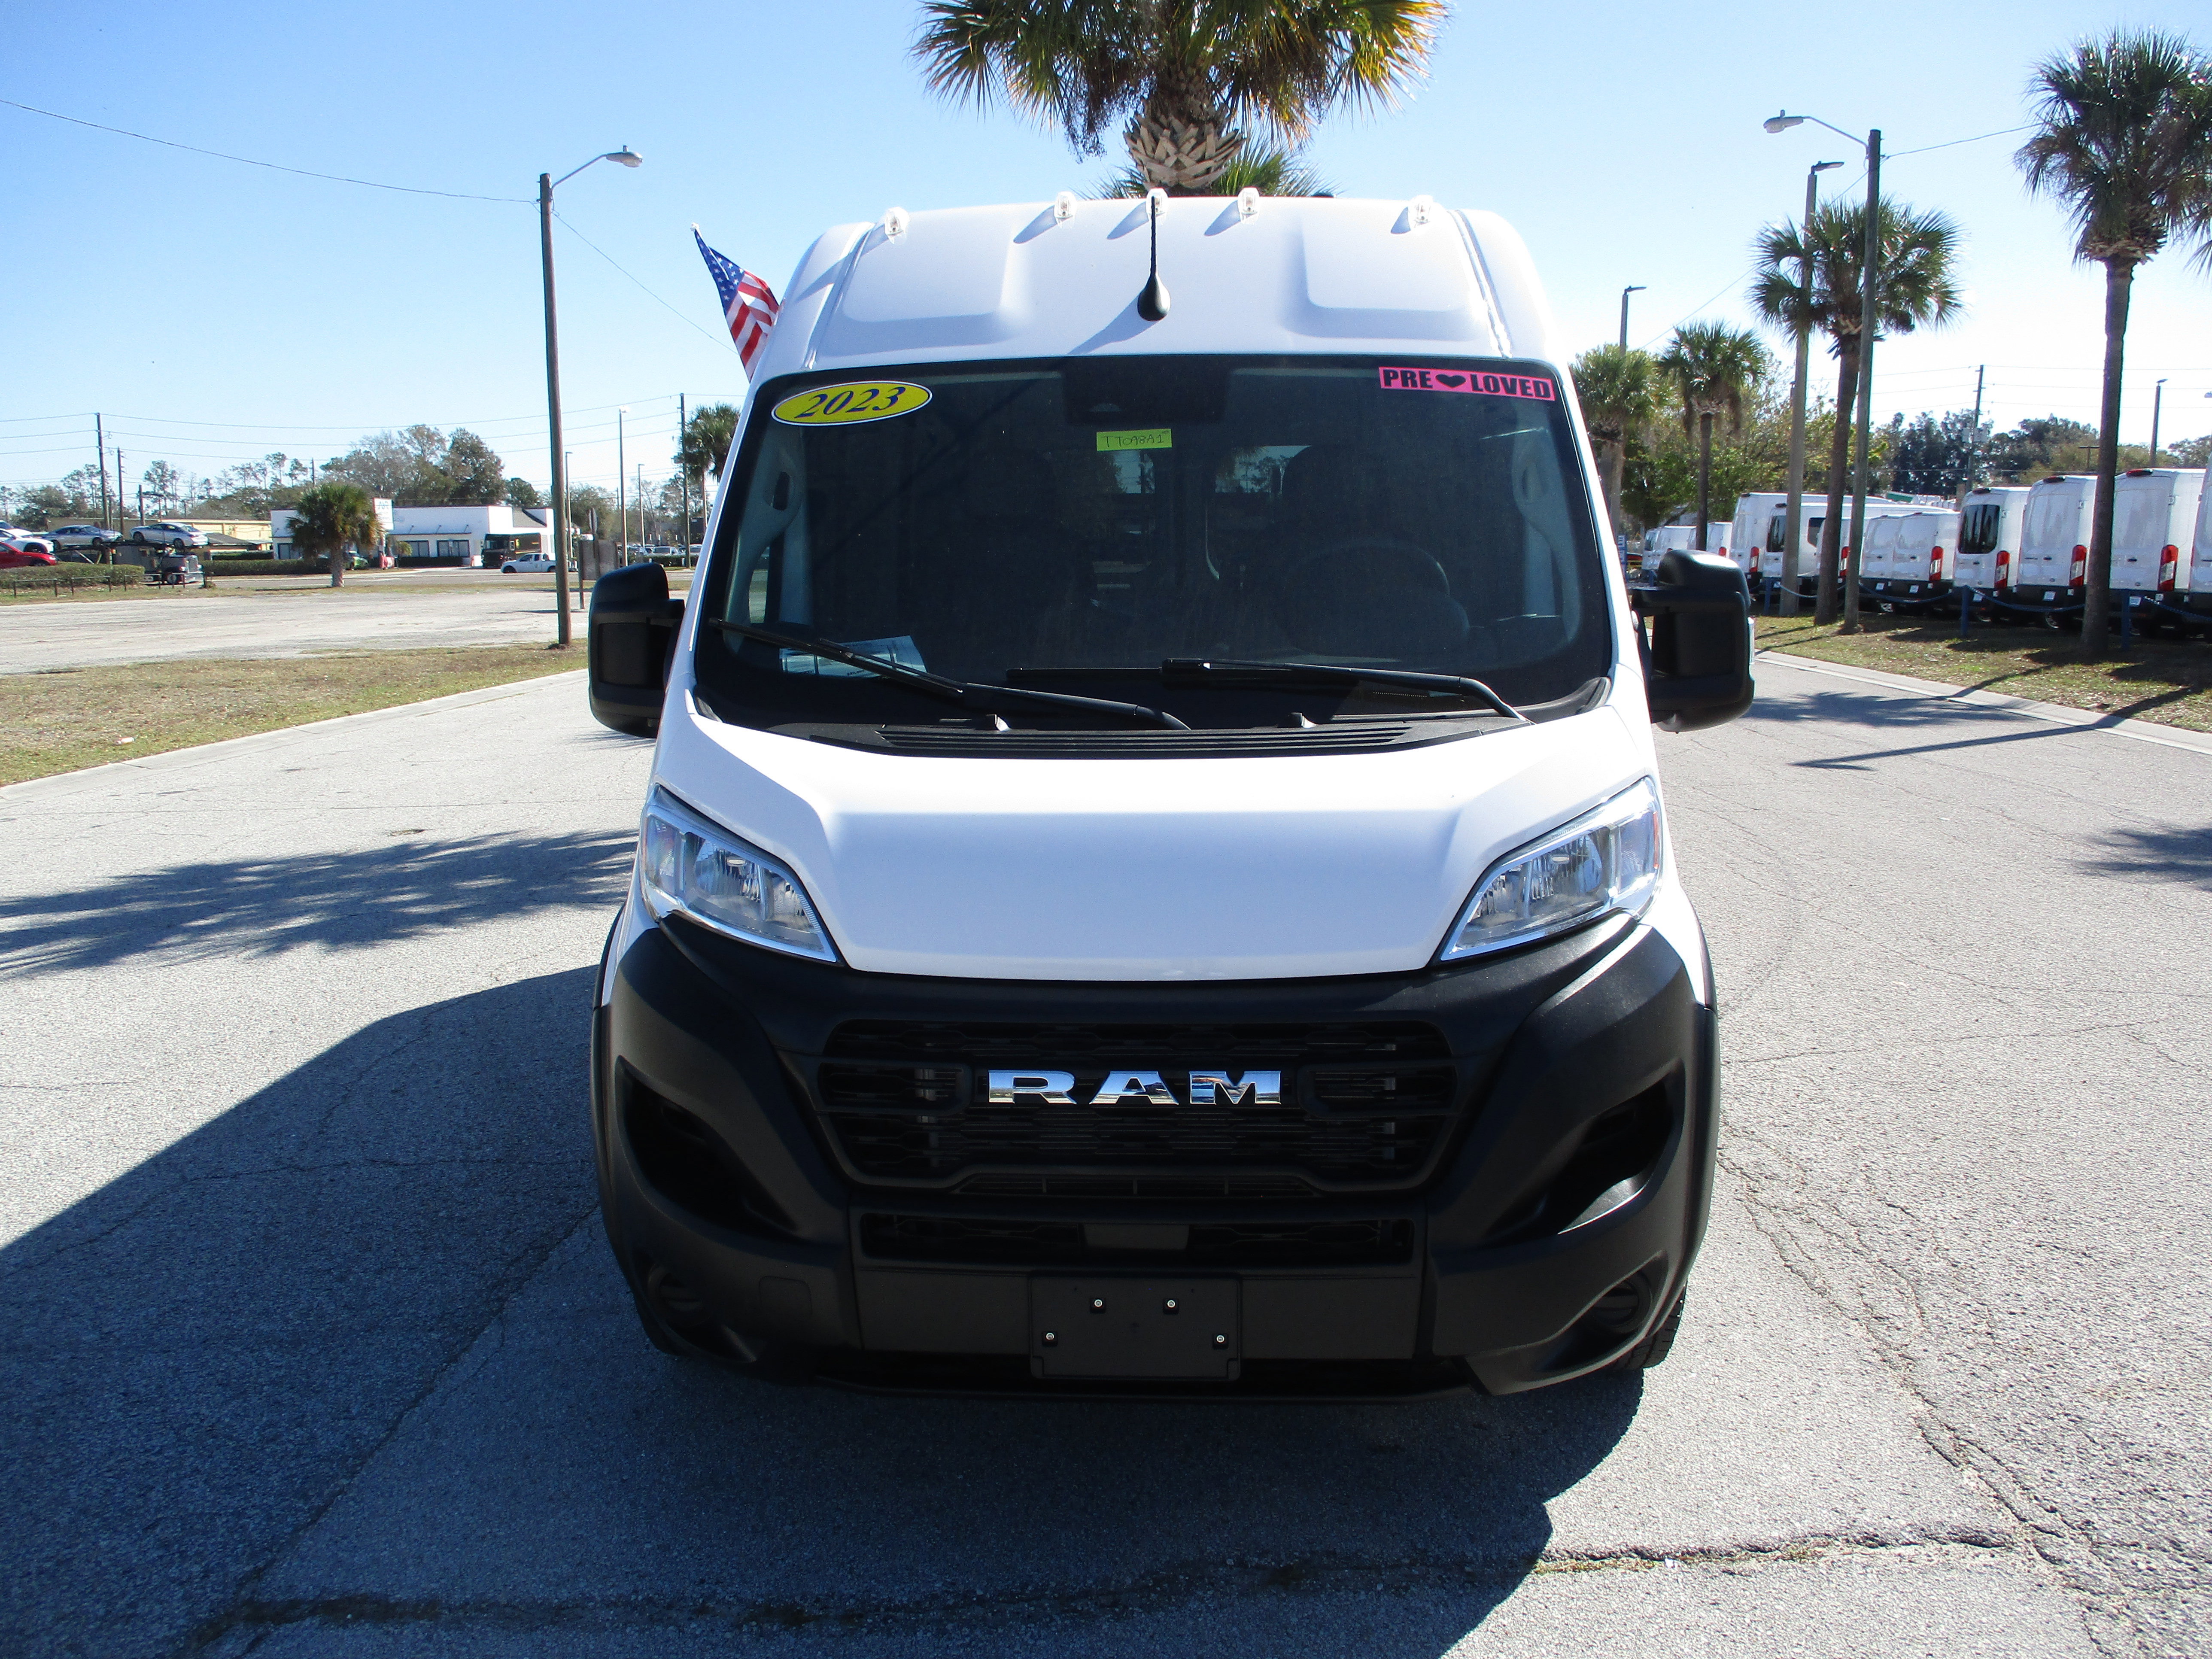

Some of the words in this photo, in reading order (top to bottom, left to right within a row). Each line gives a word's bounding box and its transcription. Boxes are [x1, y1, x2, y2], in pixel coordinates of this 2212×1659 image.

[1382, 369, 1433, 389] PRE
[1470, 374, 1551, 398] LOVED
[794, 387, 906, 418] 2023
[989, 1070, 1282, 1105] RAM
